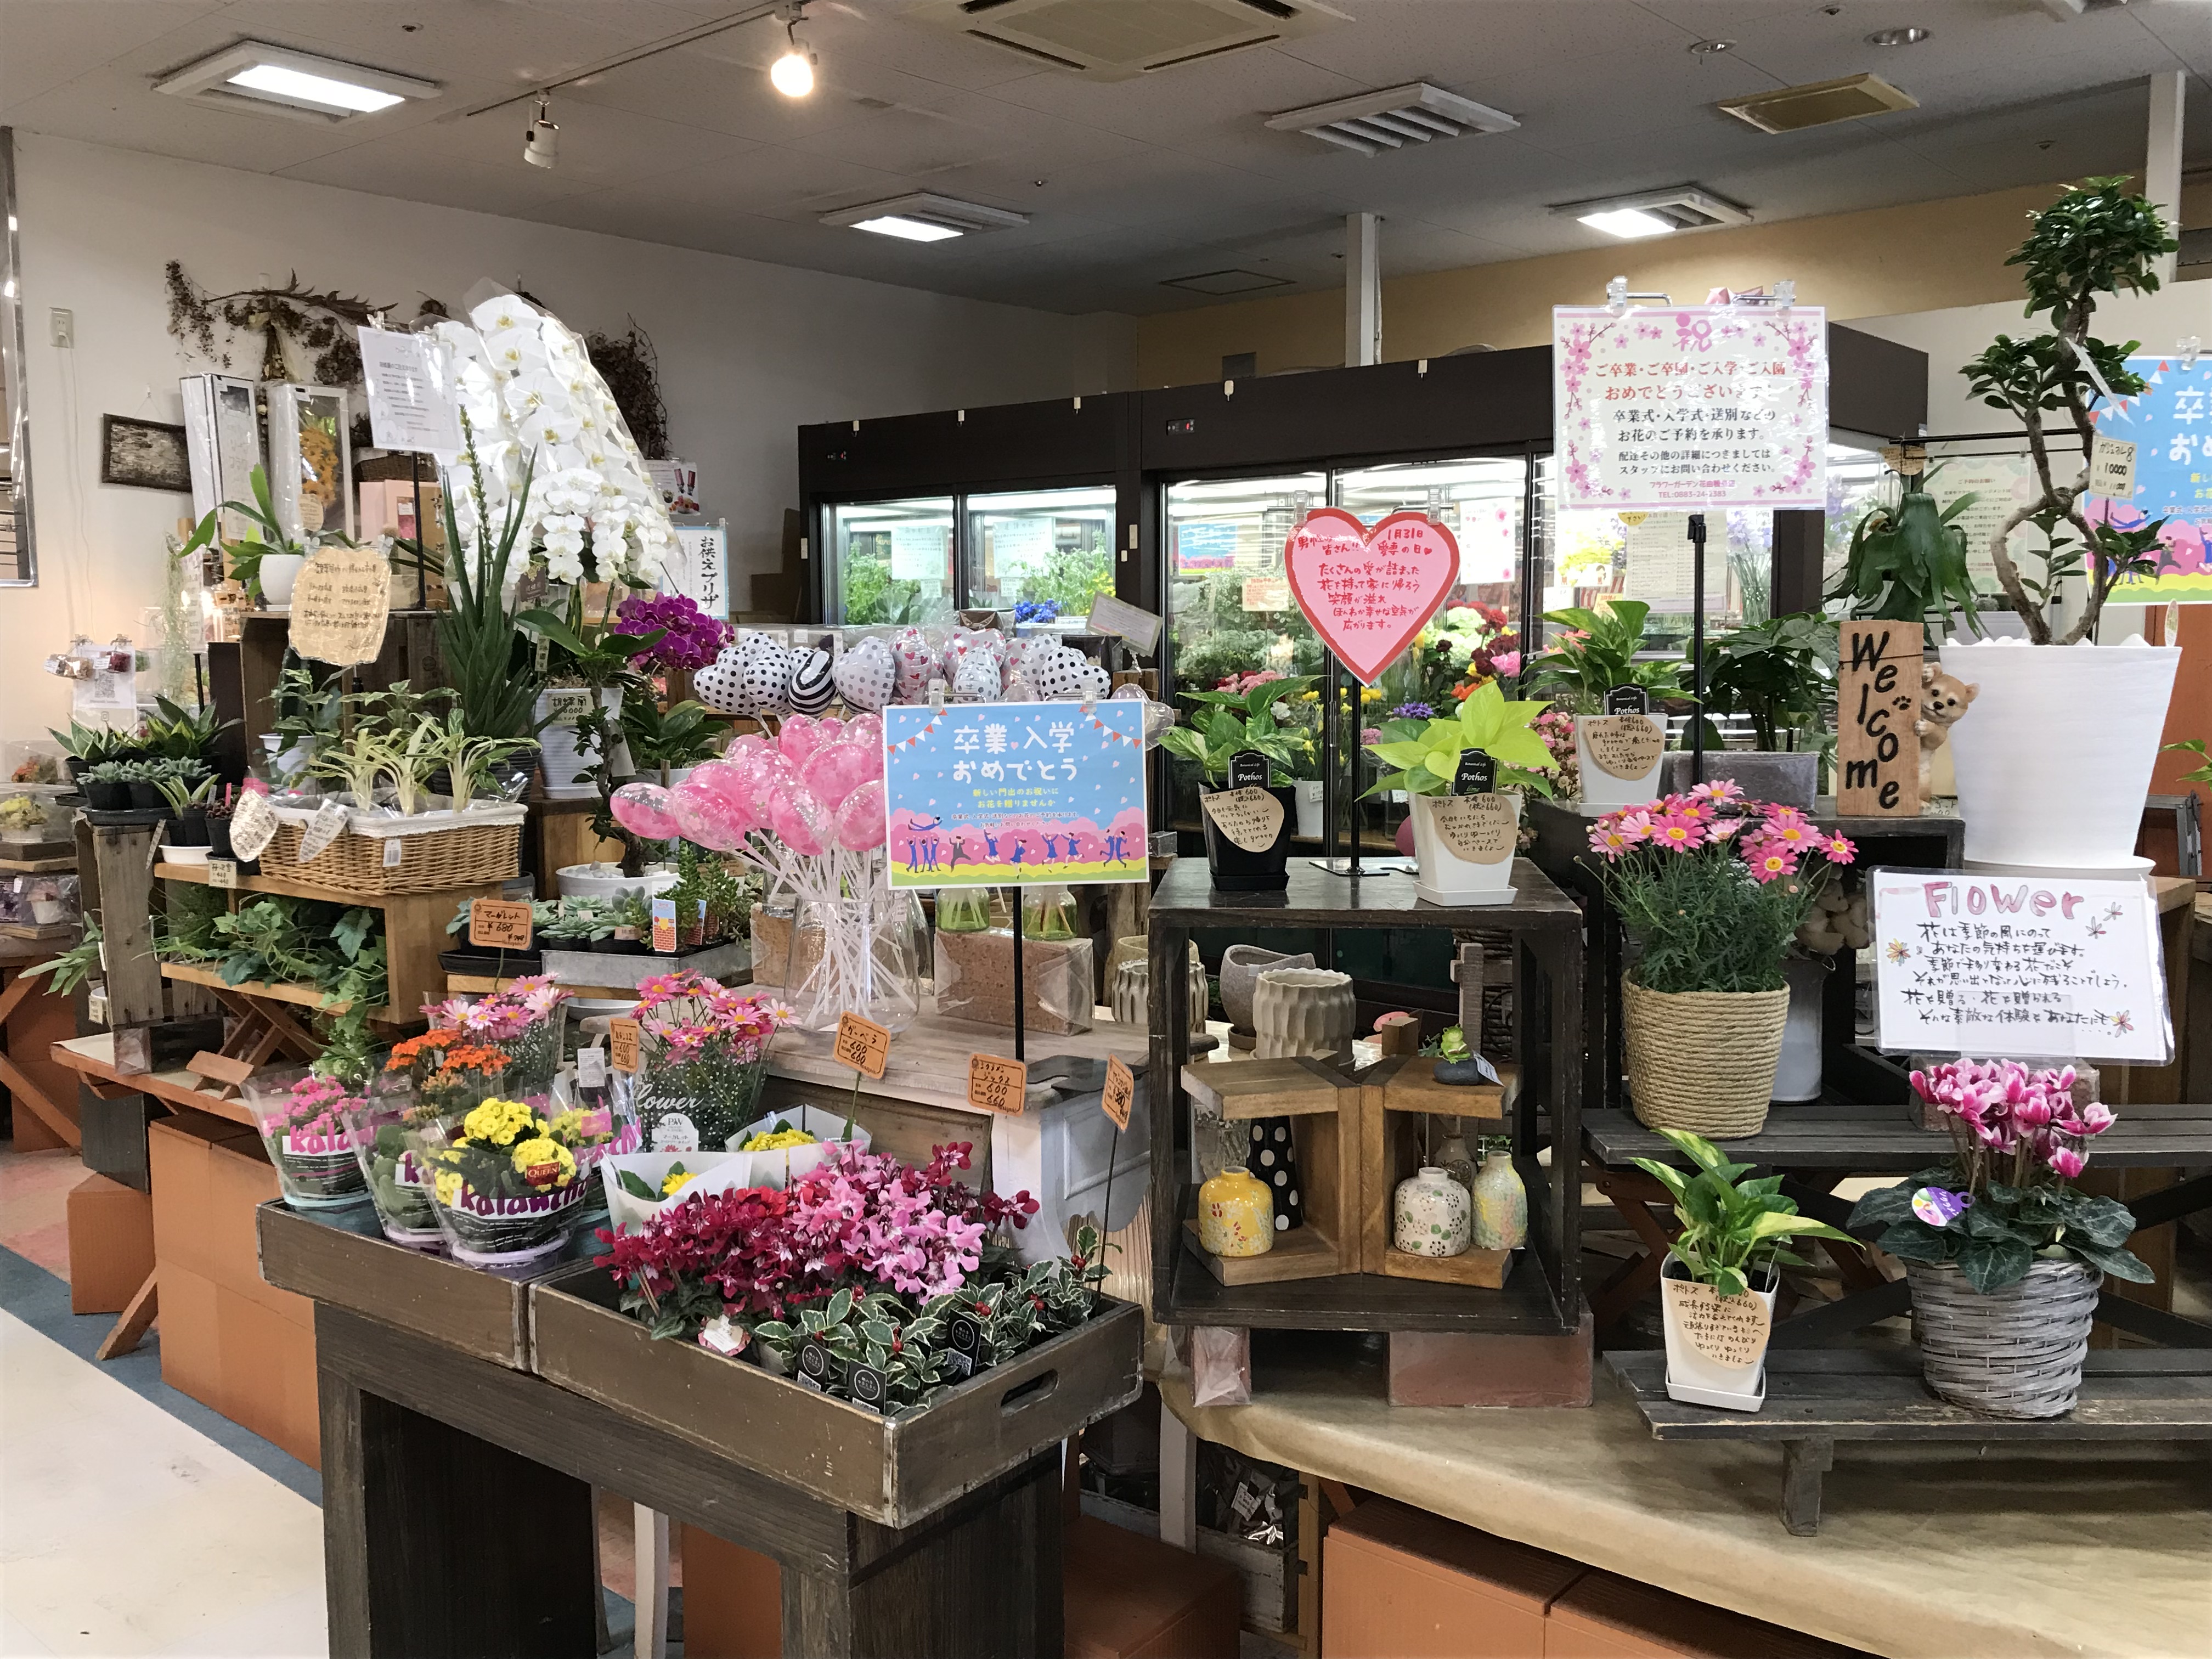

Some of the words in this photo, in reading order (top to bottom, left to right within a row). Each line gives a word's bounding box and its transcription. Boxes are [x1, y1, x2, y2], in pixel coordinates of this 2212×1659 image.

[1673, 313, 1712, 352] 祝
[1617, 427, 1765, 443] お花のご予約を承ります。
[1618, 448, 1771, 461] 配達その他の詳細につきましては
[698, 535, 719, 609] お供えプリザ
[1318, 560, 1420, 577] たくさんの愛が詰まった
[1317, 577, 1421, 594] 花を持って家に帰ろう
[1328, 592, 1387, 606] 笑顔が溢れ
[1333, 604, 1420, 618] ほんわか幸せな空気が
[1342, 618, 1392, 631] 広がります。
[1614, 705, 1640, 714] Pothos
[1845, 631, 1900, 809] Welcome
[953, 723, 1008, 754] 卒業
[1023, 721, 1074, 753] 入学
[952, 758, 1077, 785] おめでとう
[1238, 772, 1262, 781] Pothos
[1461, 771, 1488, 781] Pothos
[978, 799, 1056, 808] お花を贈りませんか
[1922, 881, 2084, 919] Flower
[484, 911, 521, 919] マーガレット
[496, 923, 514, 932] 680
[1917, 921, 2051, 943] 花は季節の風にのって
[1932, 941, 2085, 958] あなたの気持ちを運びます。
[850, 1041, 867, 1054] 600
[850, 1051, 866, 1065] 660
[986, 1082, 1008, 1096] 600
[986, 1094, 1006, 1107] 660
[528, 1166, 558, 1177] QUEEN
